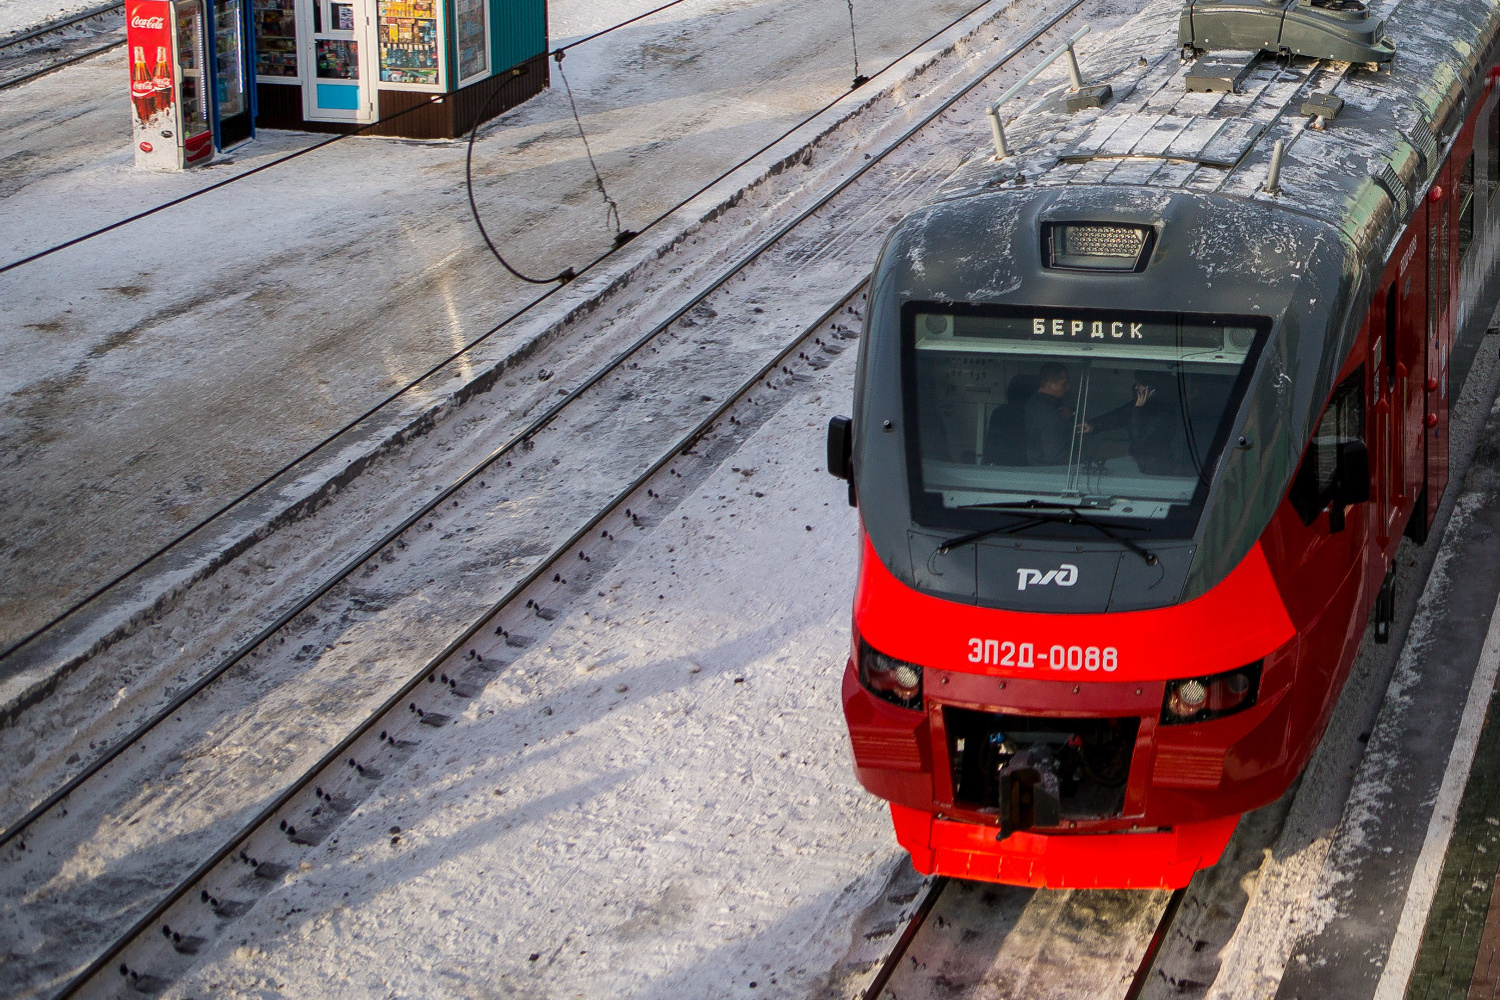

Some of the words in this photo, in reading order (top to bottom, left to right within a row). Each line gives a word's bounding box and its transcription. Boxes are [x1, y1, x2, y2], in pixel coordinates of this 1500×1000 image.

[131, 15, 165, 30] Coca-Cola
[1033, 318, 1143, 339] БЕРДСК
[967, 637, 1118, 672] ЭП2Д-0088
